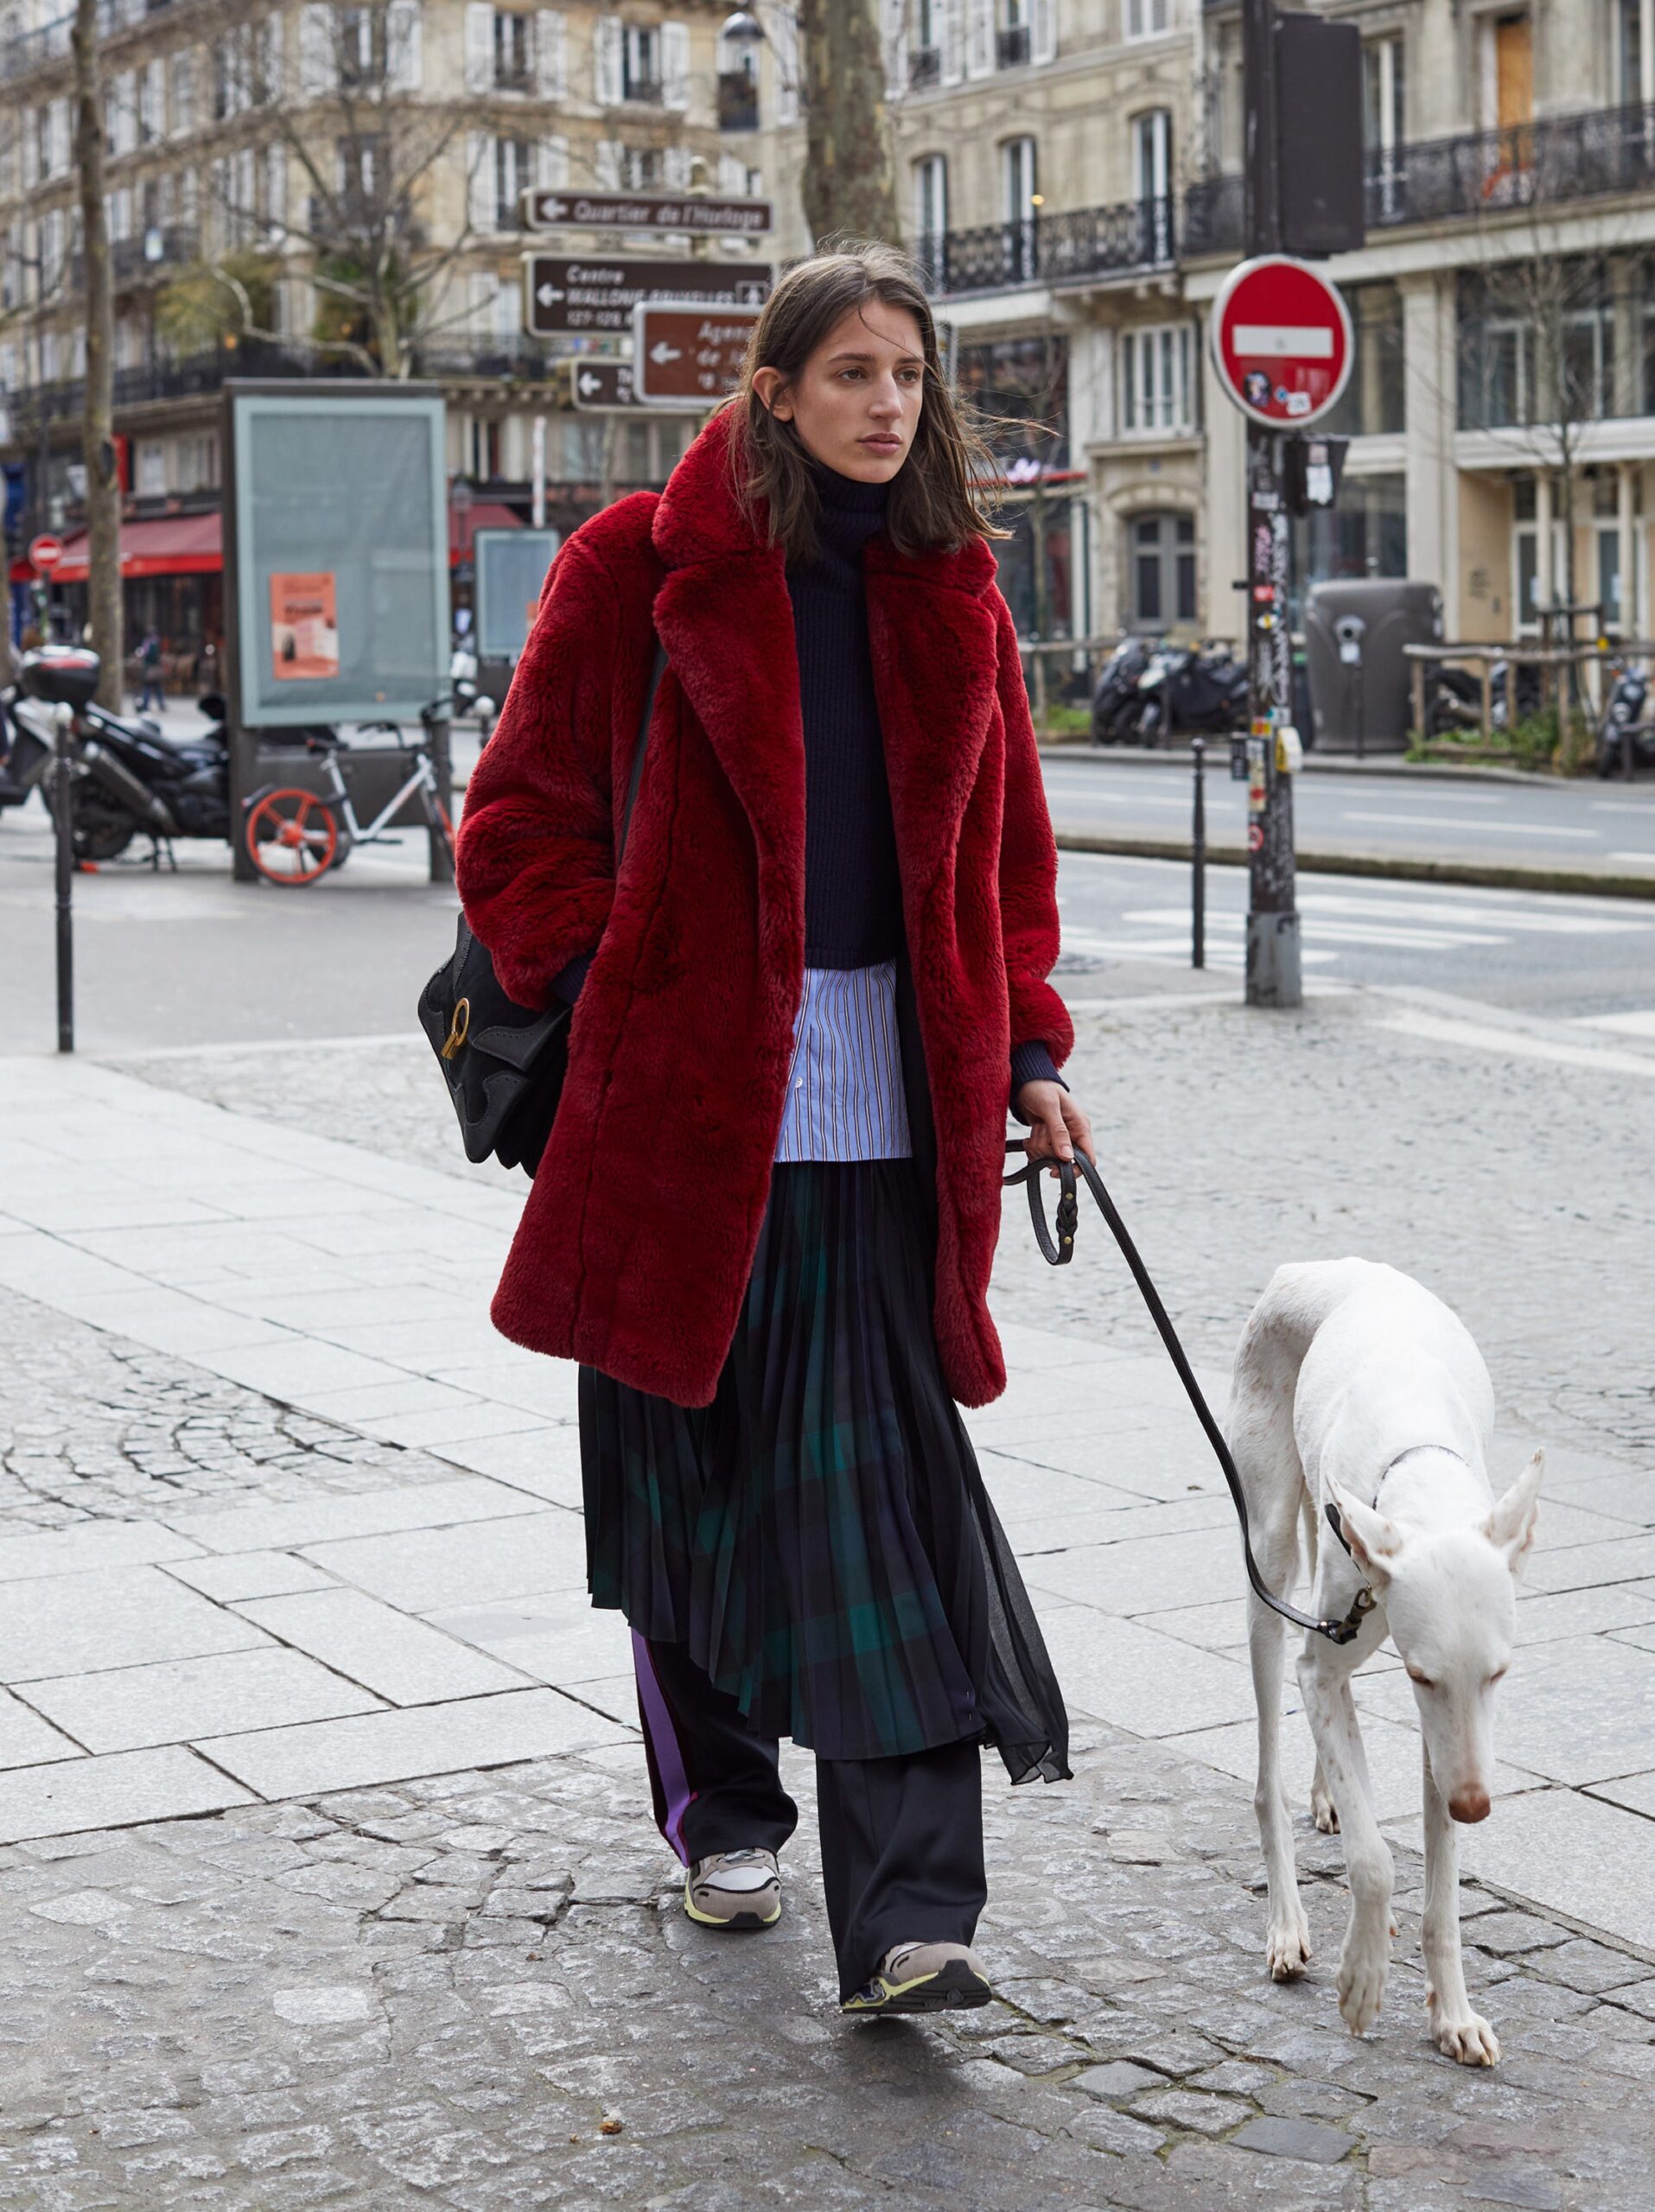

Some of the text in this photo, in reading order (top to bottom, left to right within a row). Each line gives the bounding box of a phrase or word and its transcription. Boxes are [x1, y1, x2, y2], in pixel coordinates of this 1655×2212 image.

[574, 200, 649, 223] Quartier
[657, 208, 679, 225] de
[566, 264, 625, 284] Centre
